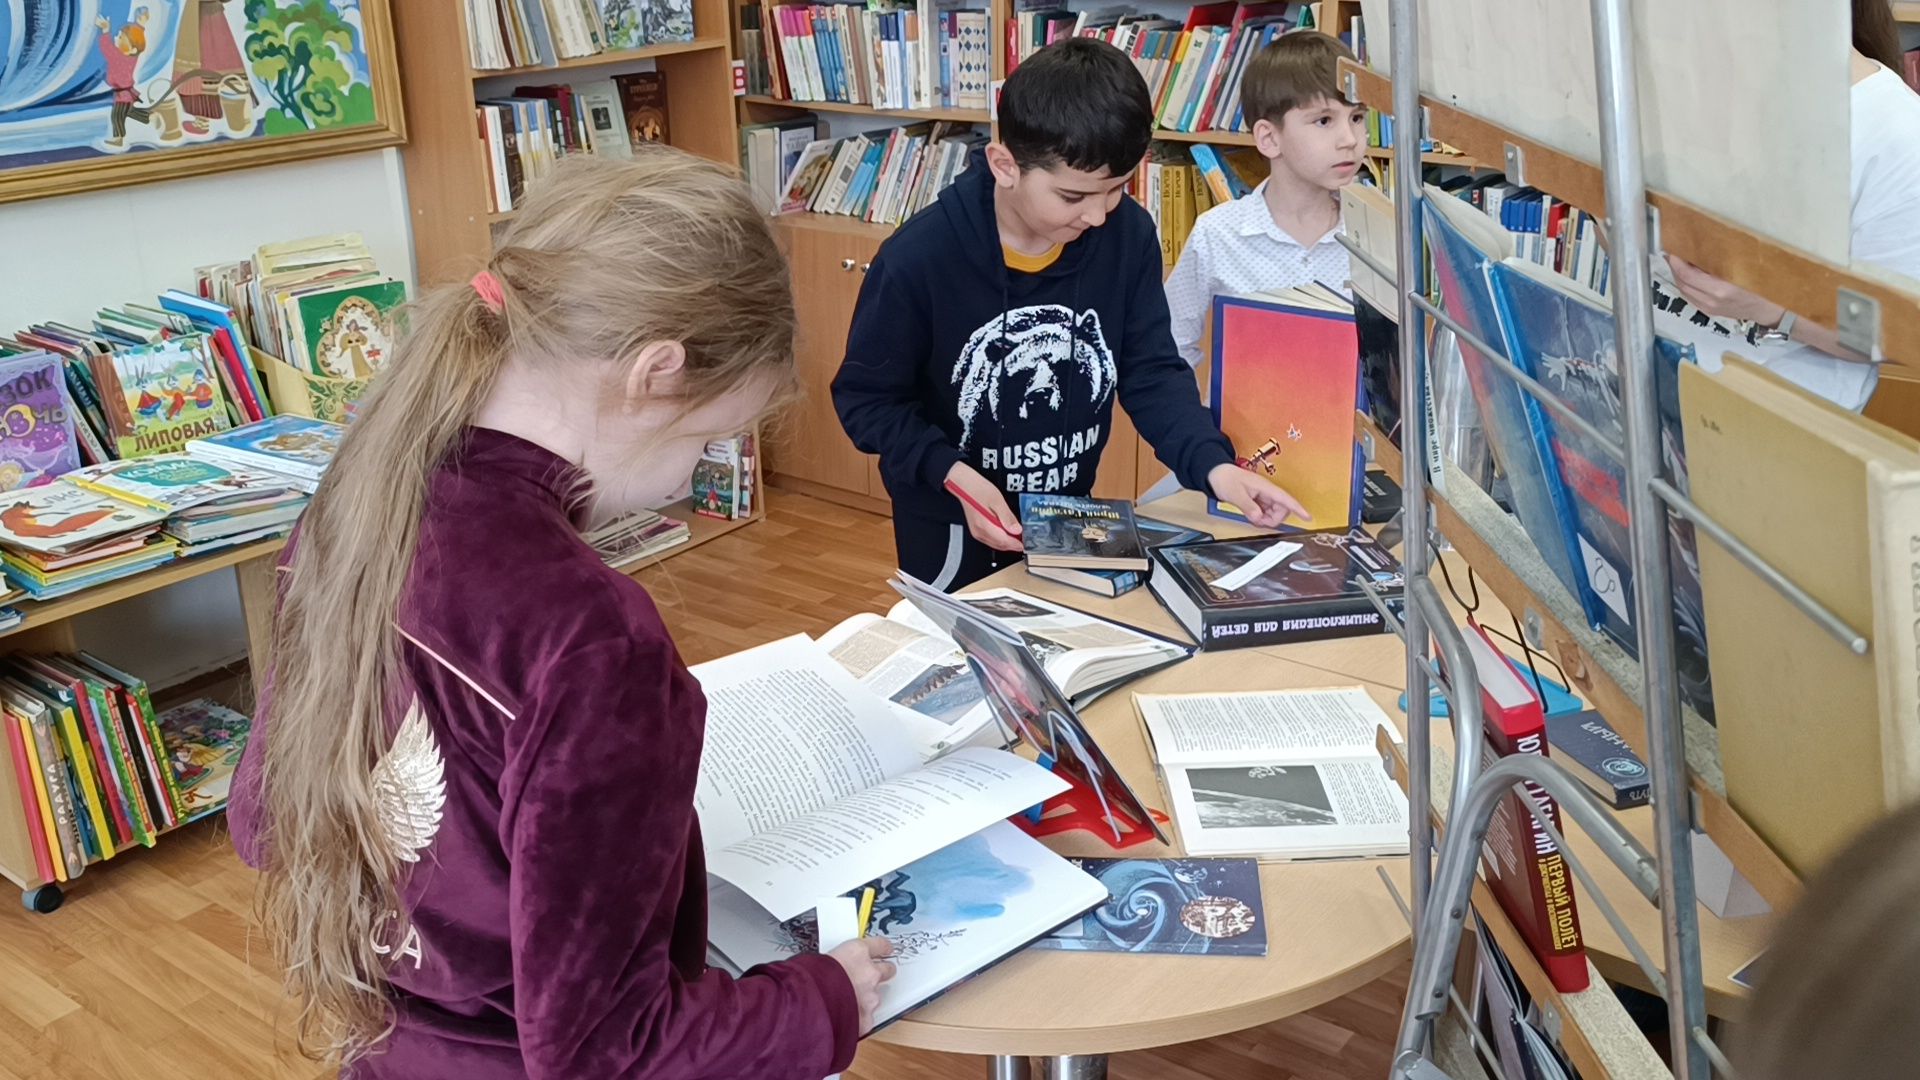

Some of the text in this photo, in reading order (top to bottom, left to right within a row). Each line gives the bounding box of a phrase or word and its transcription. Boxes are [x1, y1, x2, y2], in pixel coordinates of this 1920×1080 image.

[134, 416, 216, 453] ЛИПОВАЯ
[982, 424, 1100, 470] RUSSIAN
[1006, 462, 1079, 492] BEAR
[1211, 612, 1379, 639] ЭНЦИКЛОПЕДИЯ ДЛЯ ДЕТЕЙ
[1547, 854, 1579, 949] ПЕРВЫЙ ПОЛЁТ
